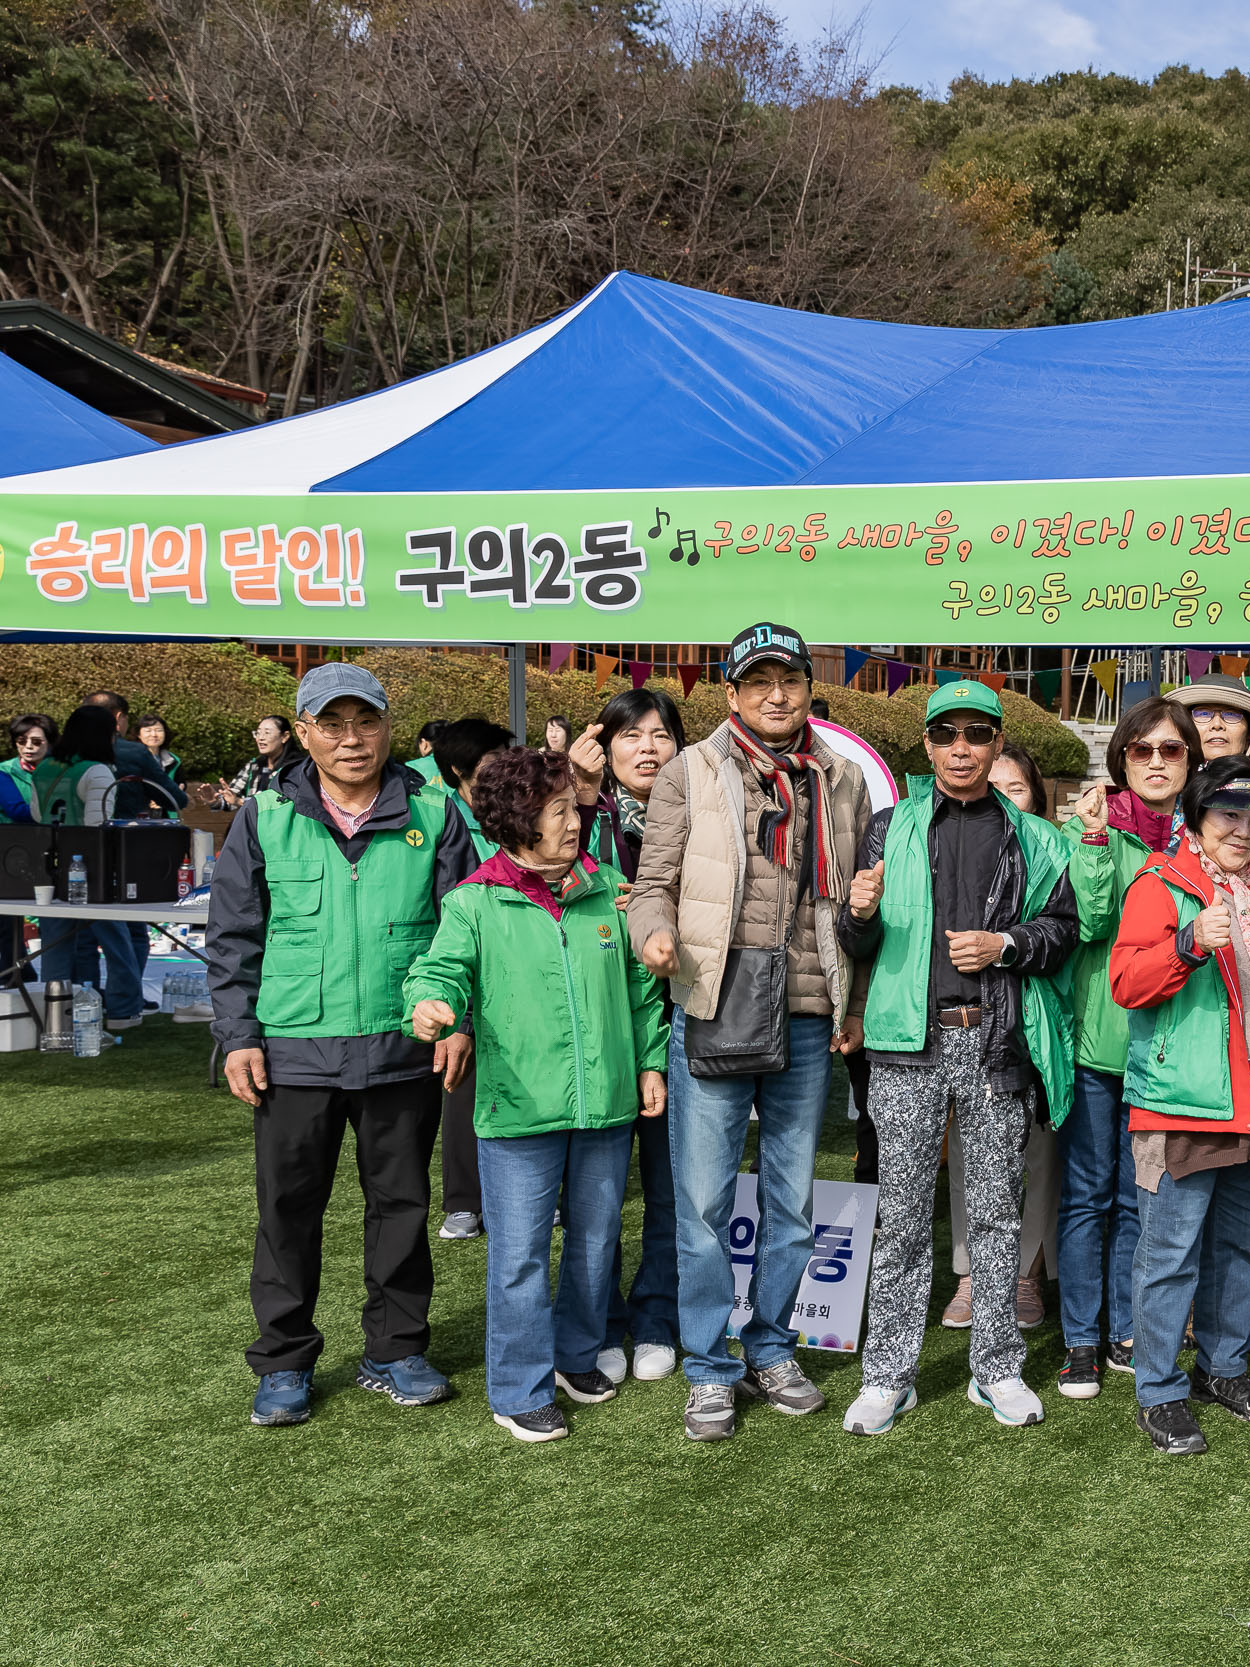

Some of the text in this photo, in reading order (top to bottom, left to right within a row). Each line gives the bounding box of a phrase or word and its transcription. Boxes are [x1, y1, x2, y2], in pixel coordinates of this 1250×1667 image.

[29, 523, 643, 608] 승리의 달인! 구의2동
[704, 513, 829, 562] 구의2동
[837, 509, 973, 566] 새마을,
[990, 509, 1134, 558] 이겼다!
[942, 572, 1072, 621] 구의2동
[1083, 569, 1223, 629] 새마을,
